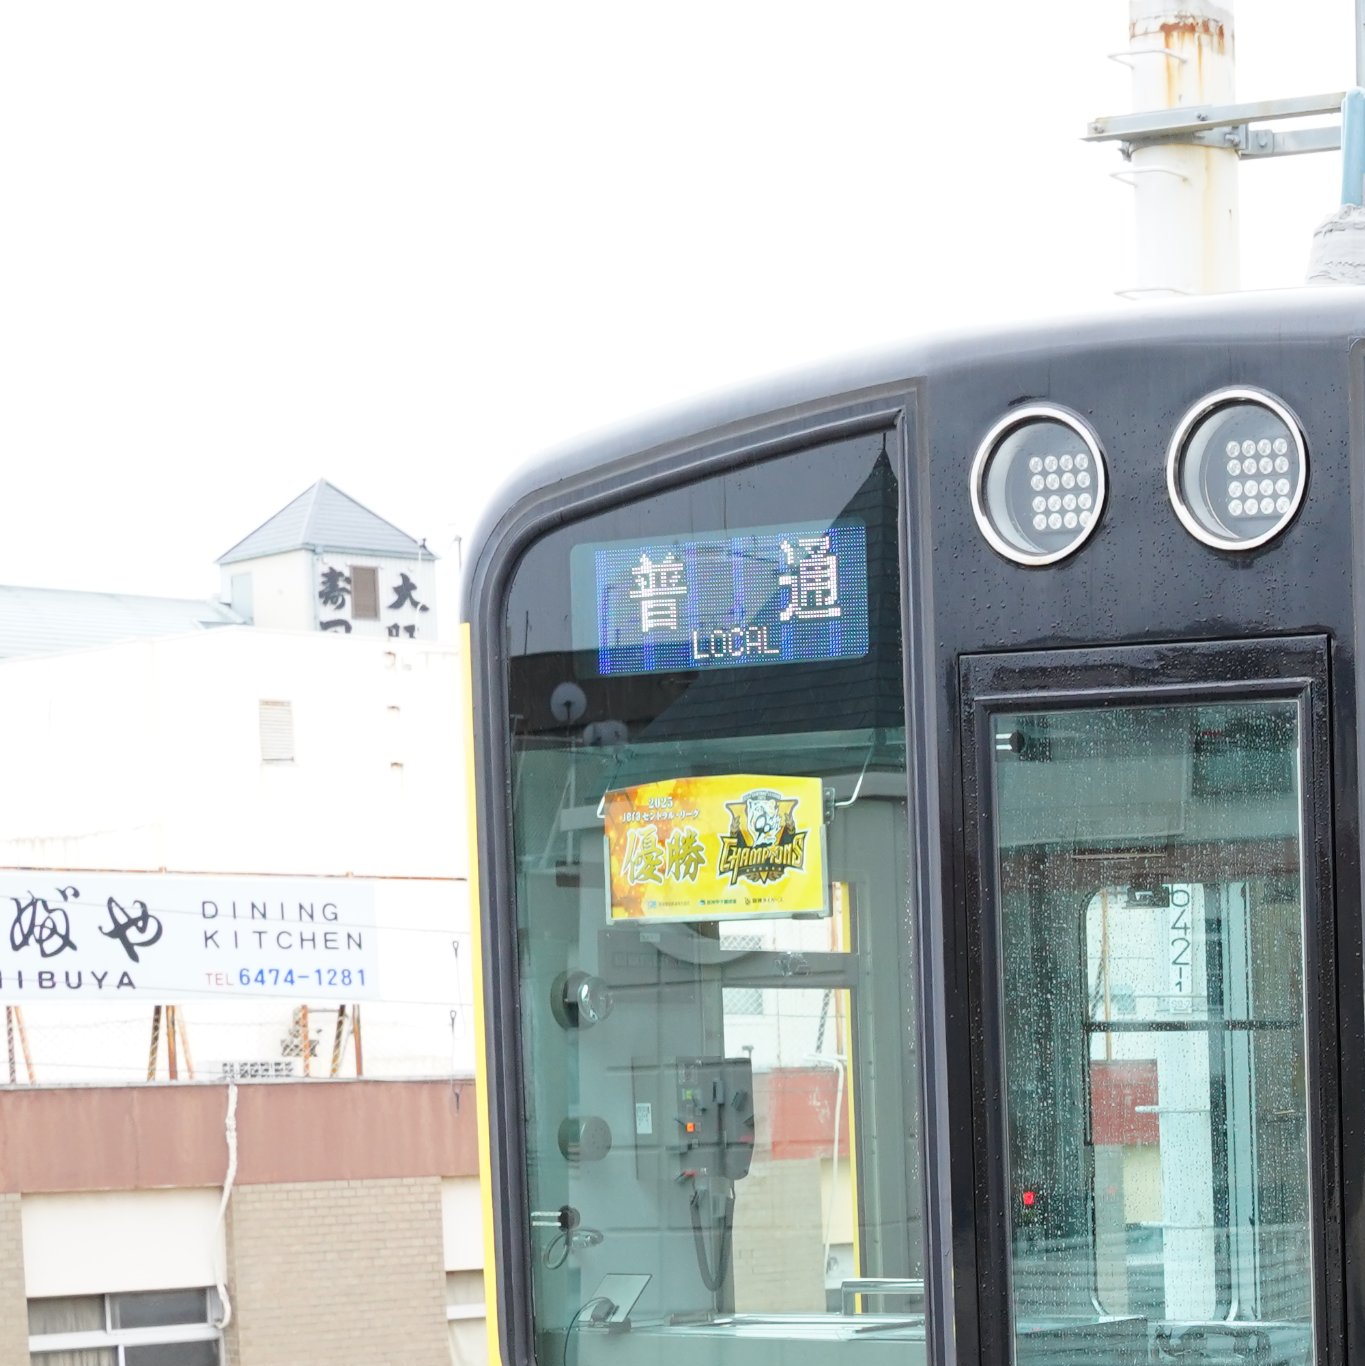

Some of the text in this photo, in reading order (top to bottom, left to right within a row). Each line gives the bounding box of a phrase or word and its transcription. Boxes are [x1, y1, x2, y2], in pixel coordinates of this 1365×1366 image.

[629, 536, 841, 633] 普通
[692, 626, 780, 660] LOCAL
[648, 797, 673, 809] 2025
[621, 824, 707, 885] 優勝
[718, 832, 808, 886] CHAMPIONS
[202, 901, 340, 922] DINING
[203, 931, 363, 951] KITCHEN
[0, 970, 136, 990] IBUYA
[204, 967, 367, 987] TEL 6474-1281
